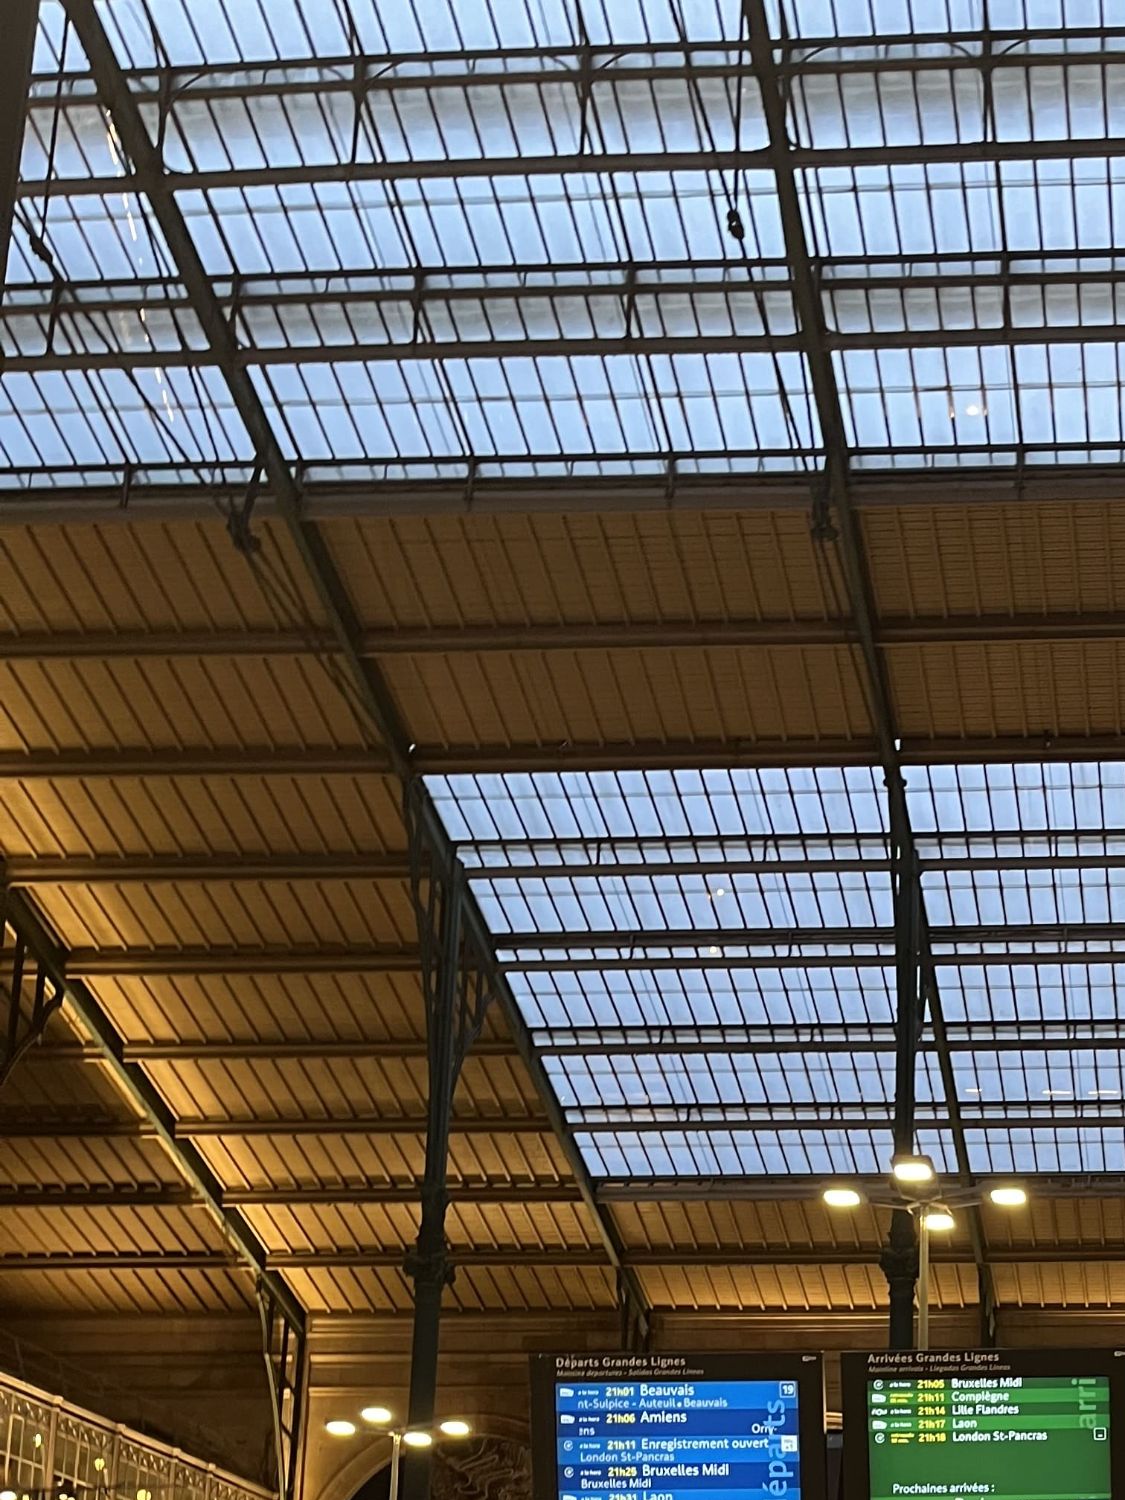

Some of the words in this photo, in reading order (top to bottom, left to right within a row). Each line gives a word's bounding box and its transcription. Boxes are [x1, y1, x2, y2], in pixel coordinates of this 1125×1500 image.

[555, 1355, 599, 1369] Départs
[602, 1356, 647, 1368] Grandes
[651, 1356, 686, 1369] Lignes
[867, 1353, 913, 1364] Arrivées
[916, 1353, 961, 1363] Grandes
[964, 1353, 999, 1364] Lignes
[917, 1379, 945, 1389] 21h05
[951, 1378, 998, 1389] Bruxelles
[999, 1377, 1023, 1388] Midi
[606, 1387, 634, 1397] 21h01
[640, 1384, 695, 1396] Beauvais
[782, 1385, 794, 1395] 19
[639, 1397, 676, 1408] Auteuil
[684, 1397, 728, 1408] Beauvais
[917, 1393, 945, 1403] 21h11
[951, 1391, 1010, 1403] Compiègne
[918, 1406, 946, 1416] 21h14
[952, 1404, 974, 1415] Lille
[975, 1404, 1019, 1415] Flandres
[640, 1411, 687, 1423] Amiens
[918, 1419, 946, 1429] 21h17
[952, 1418, 977, 1429] Laon
[953, 1431, 991, 1442] London
[992, 1430, 1048, 1441] St-Pancras
[607, 1440, 636, 1450] 21h11
[641, 1437, 729, 1451] Enregistrement
[732, 1438, 769, 1449] ouvert
[580, 1451, 618, 1462] London
[621, 1451, 675, 1462] St-Pancras
[642, 1464, 699, 1477] Bruxelles
[702, 1463, 729, 1476] Midi
[581, 1478, 627, 1489] Bruxelles
[629, 1478, 652, 1489] Midi
[893, 1483, 948, 1494] Prochaines
[949, 1482, 989, 1493] arrivées
